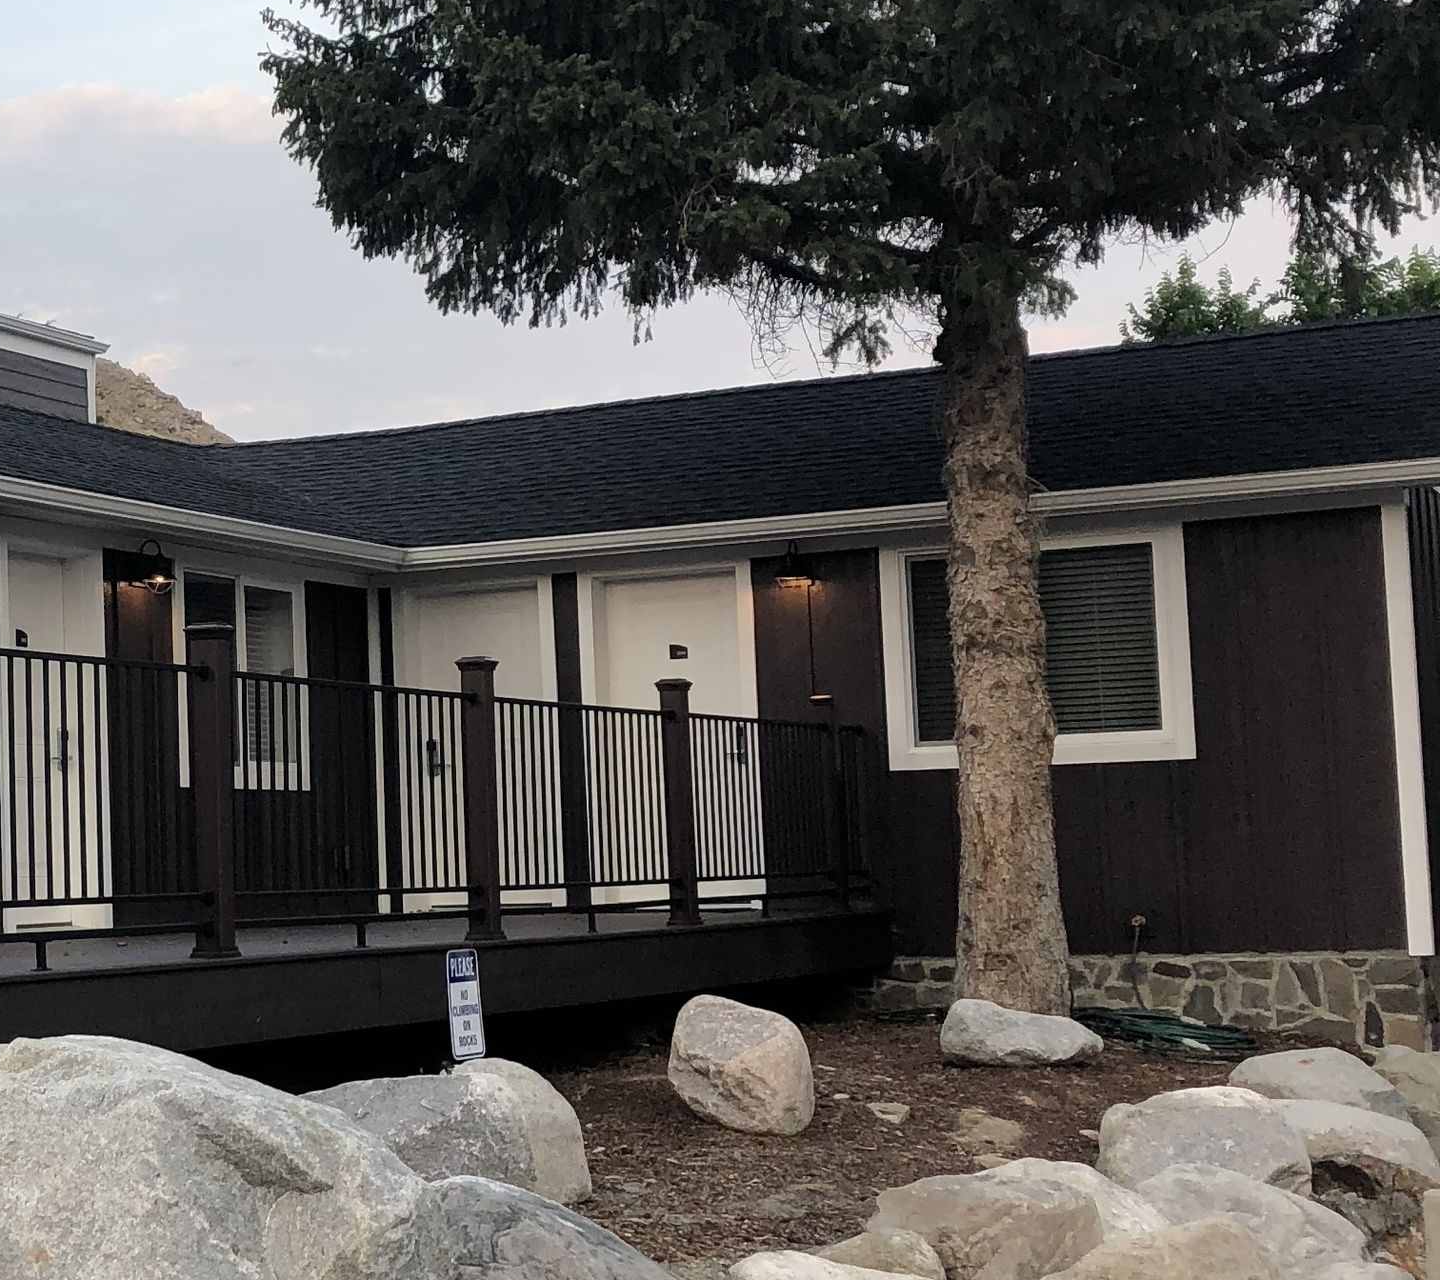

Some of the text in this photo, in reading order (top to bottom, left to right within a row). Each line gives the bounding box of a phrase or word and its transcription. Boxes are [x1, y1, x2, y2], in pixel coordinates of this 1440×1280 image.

[450, 956, 475, 978] PLEASE
[452, 1004, 479, 1017] CLIMBING
[463, 1020, 471, 1031] ON
[459, 1034, 478, 1047] ROCKS
